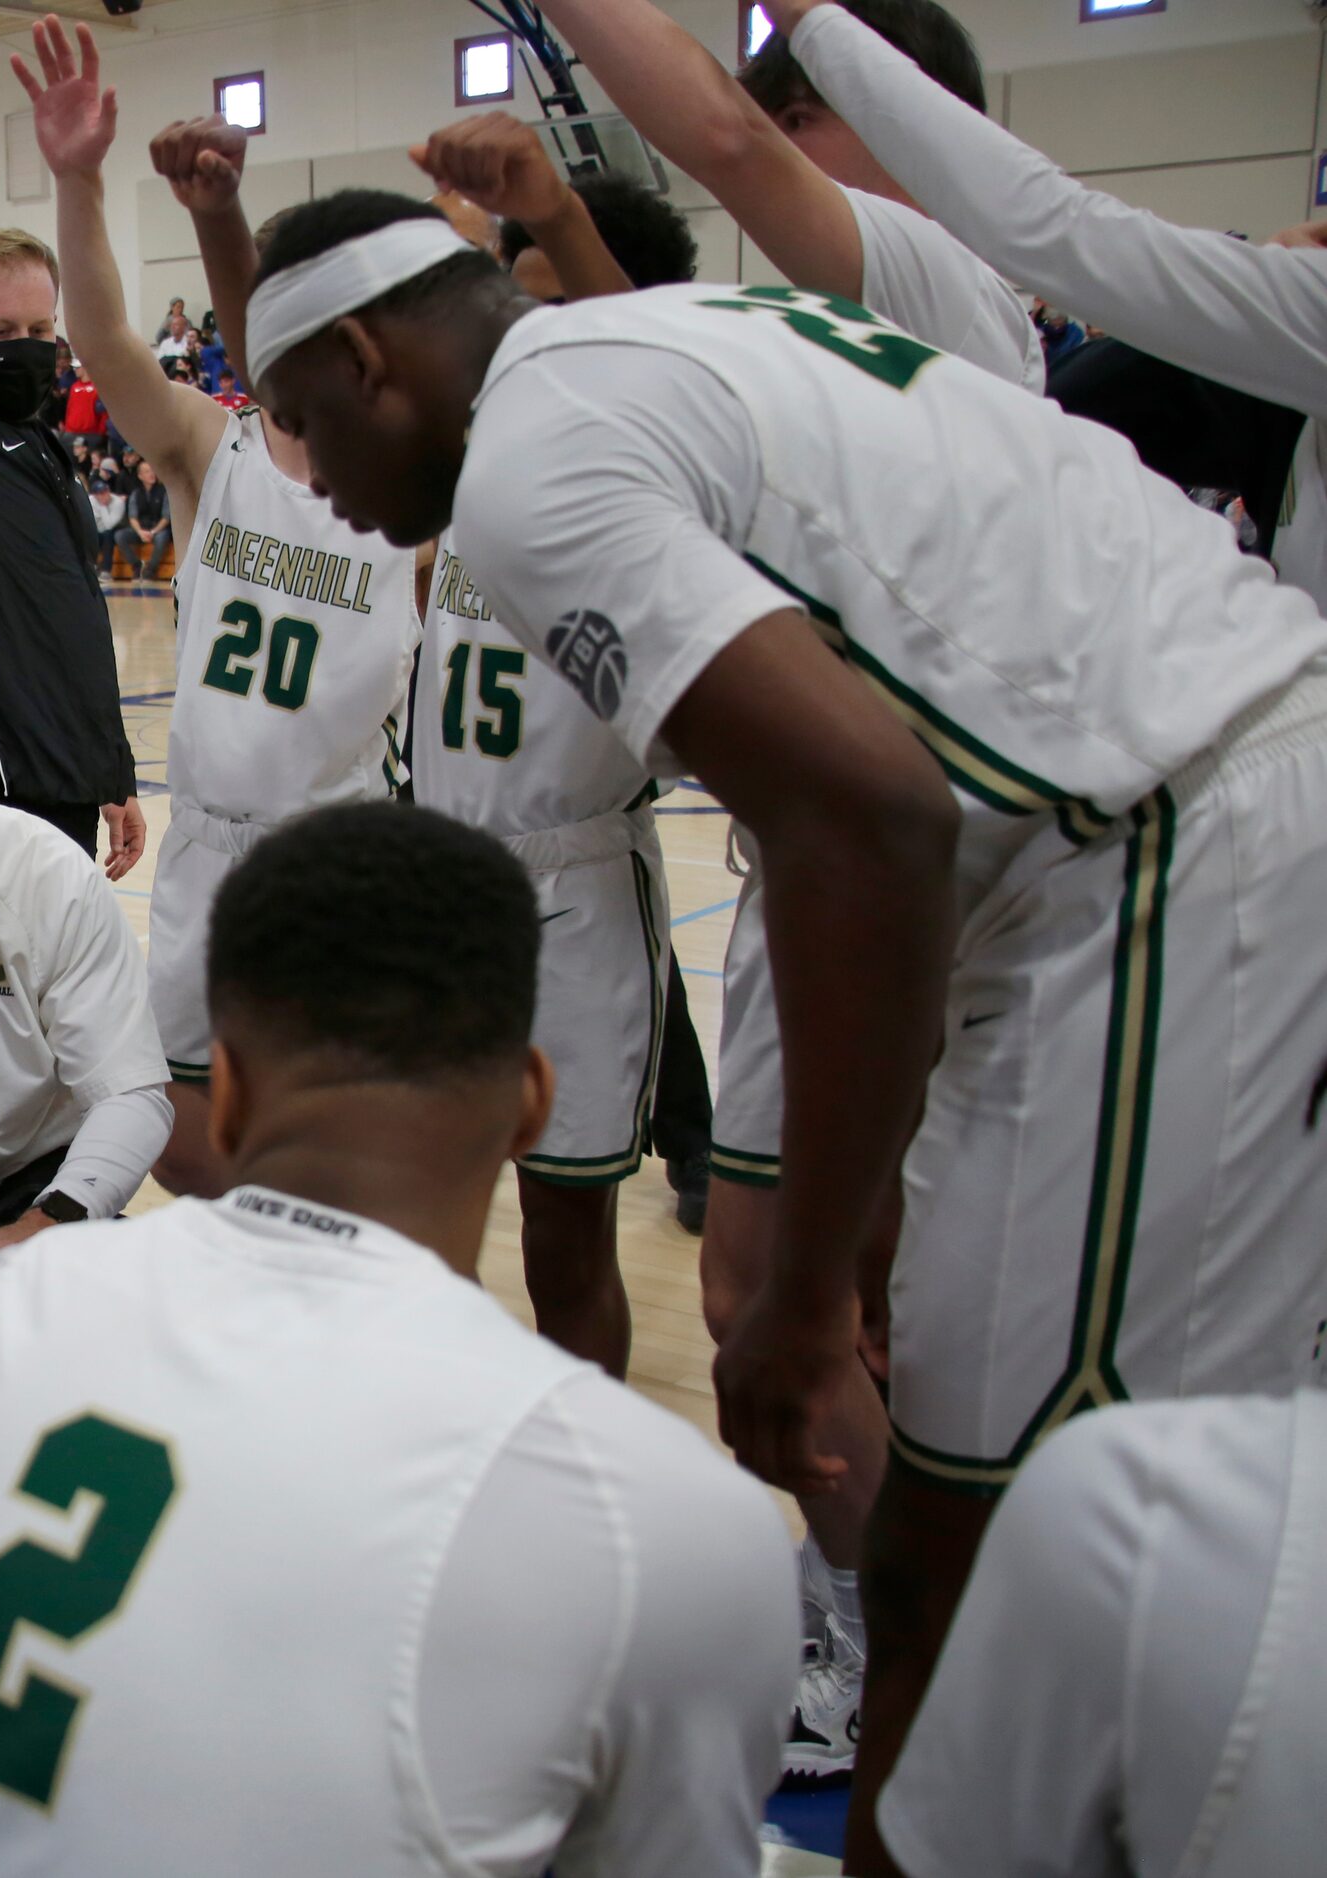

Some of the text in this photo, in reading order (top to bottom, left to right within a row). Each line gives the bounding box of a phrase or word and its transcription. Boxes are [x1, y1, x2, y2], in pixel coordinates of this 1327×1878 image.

[200, 518, 372, 614] GREENHILL
[199, 596, 322, 713] 20
[442, 639, 528, 762] 15
